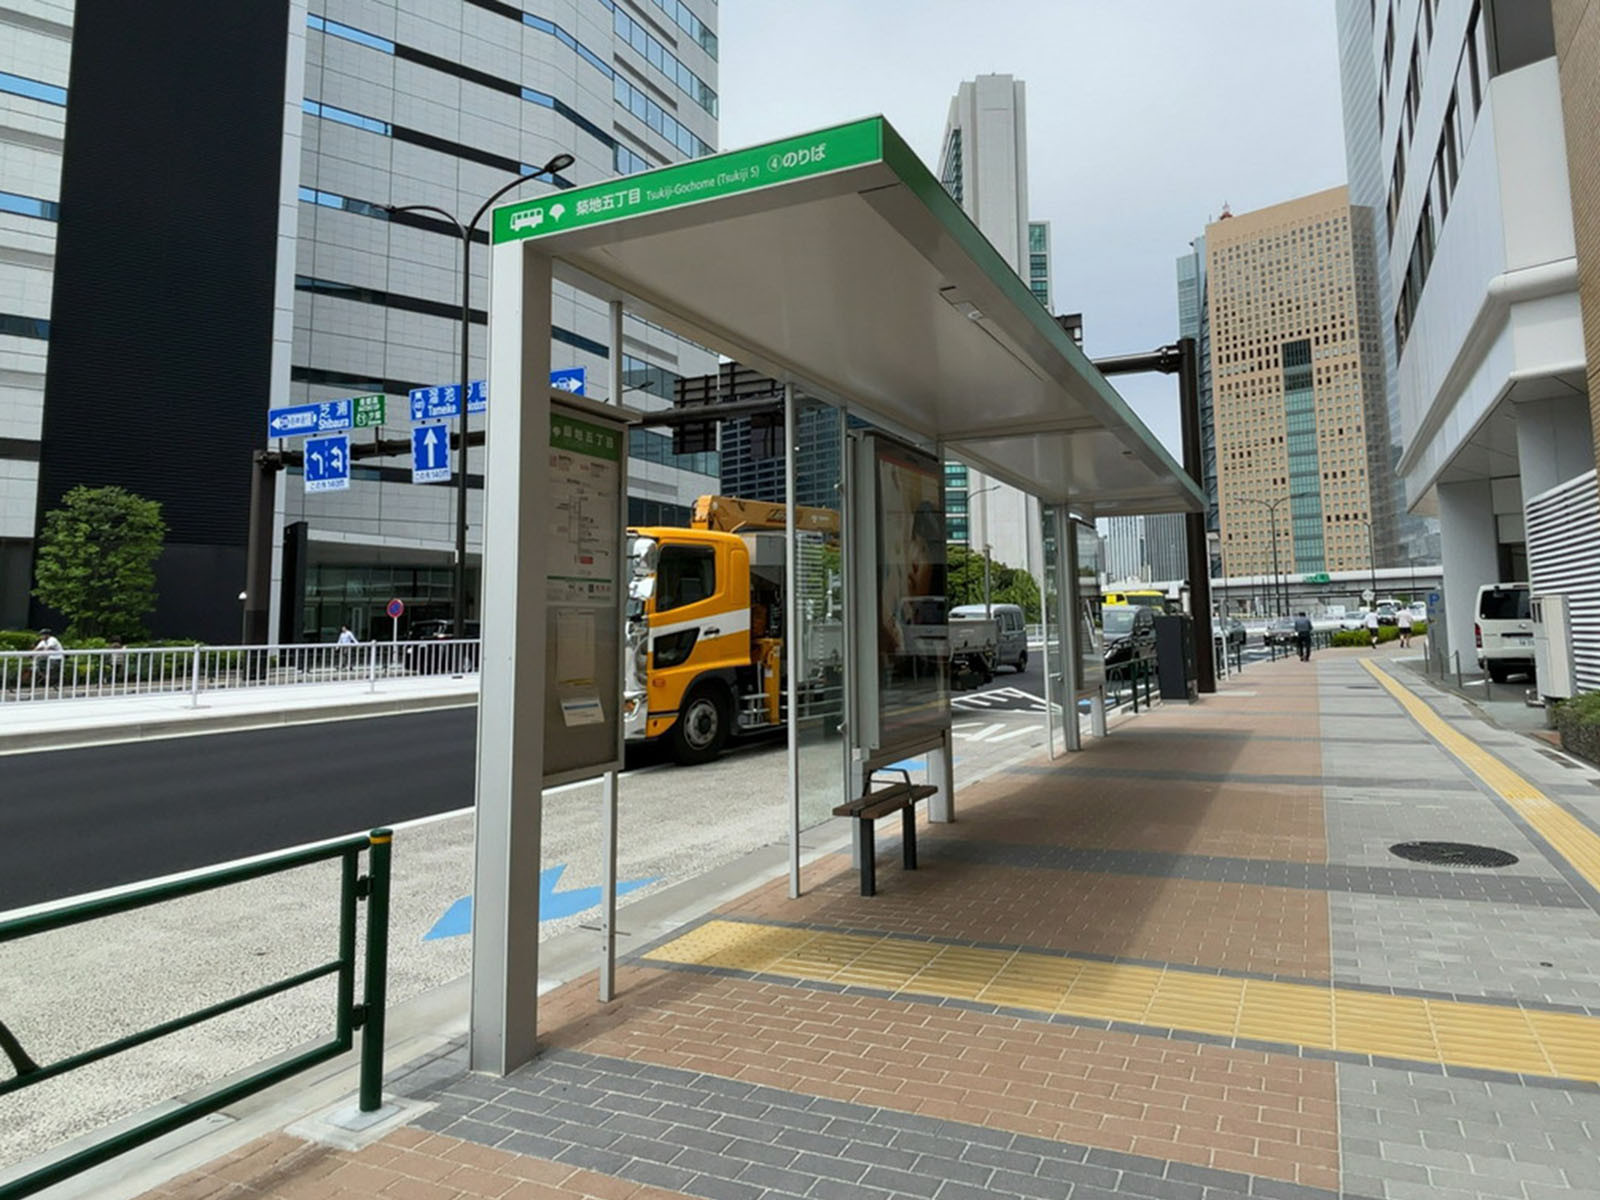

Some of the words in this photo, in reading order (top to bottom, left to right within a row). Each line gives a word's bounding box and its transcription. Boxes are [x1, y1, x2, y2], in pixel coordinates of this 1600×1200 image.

[575, 187, 641, 216] 築地五丁目
[646, 178, 716, 202] Tsukiji-Gochome
[717, 167, 749, 187] (Tsukiji
